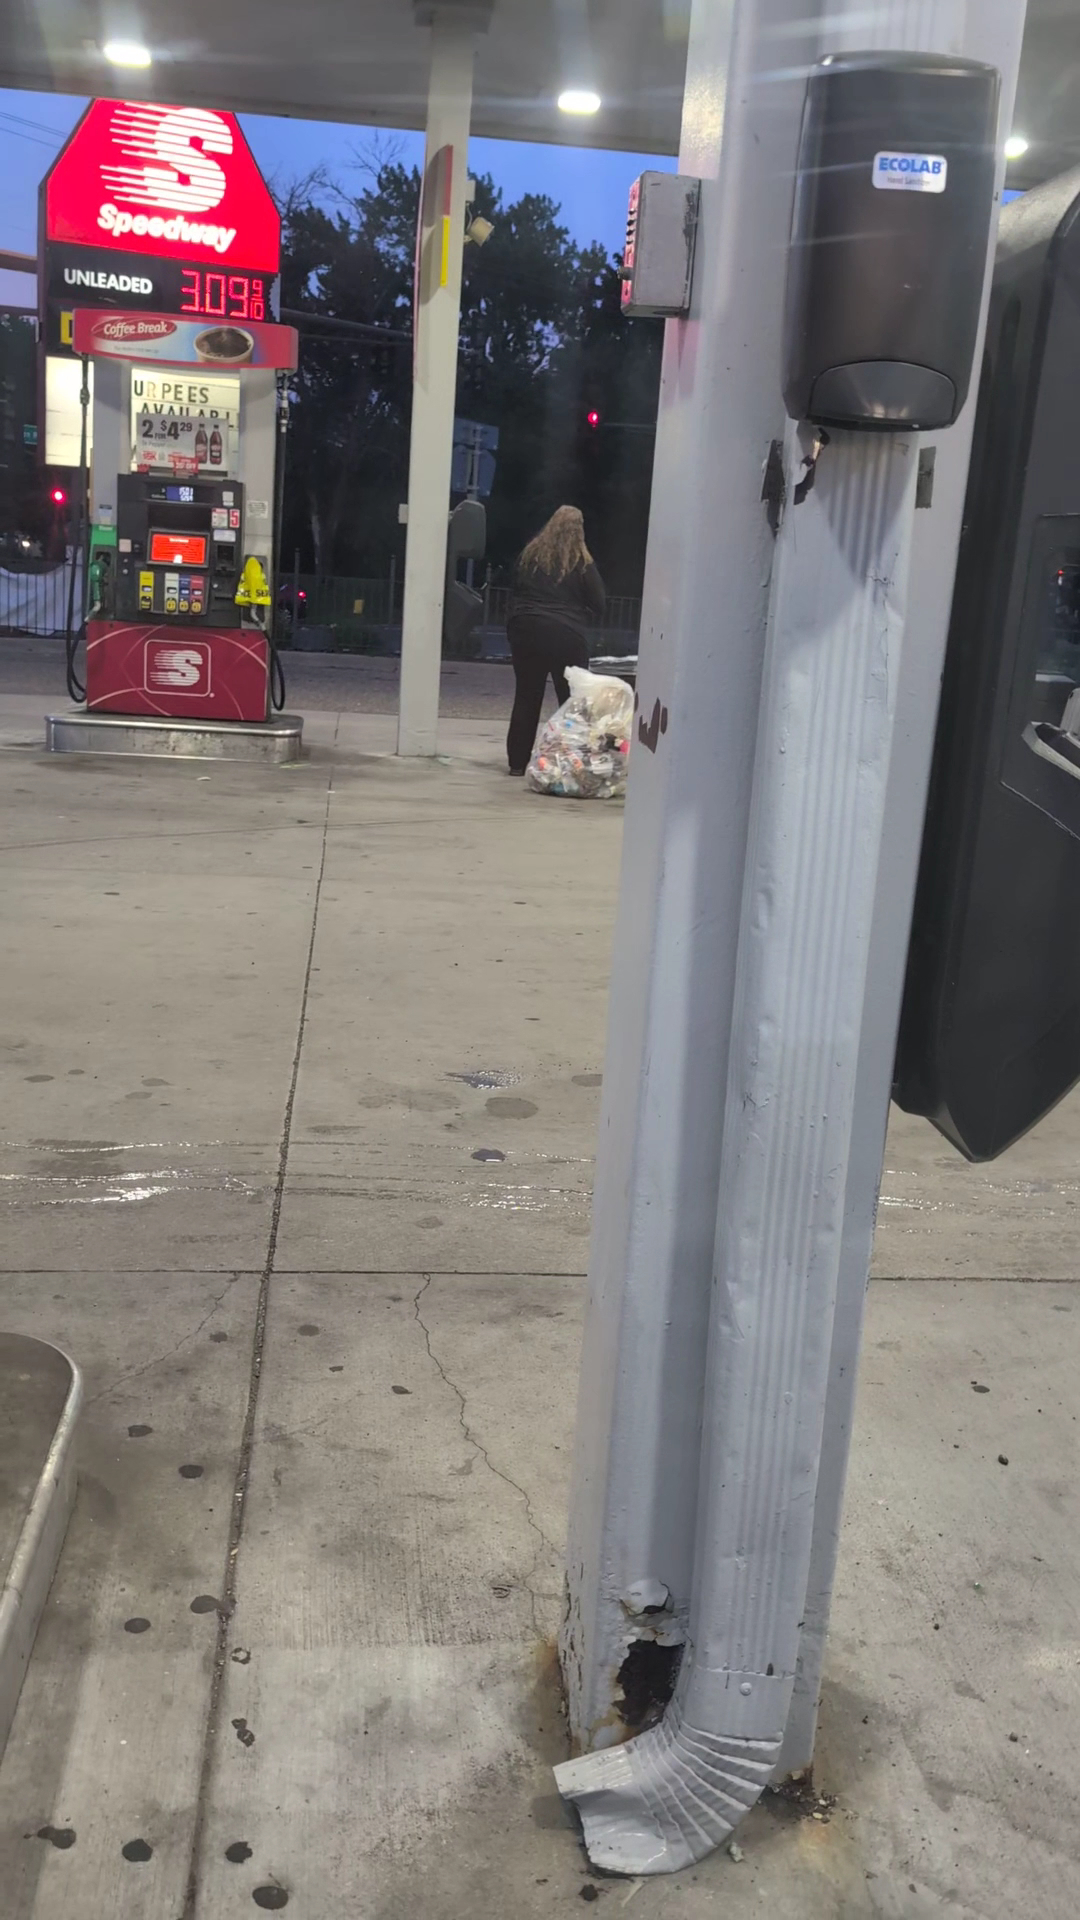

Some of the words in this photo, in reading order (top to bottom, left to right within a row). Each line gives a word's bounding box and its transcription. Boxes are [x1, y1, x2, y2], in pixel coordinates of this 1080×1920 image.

[879, 157, 942, 175] ECOLAB
[97, 203, 236, 253] Speedway
[64, 268, 153, 294] UNLEADED
[104, 322, 135, 338] Coffee
[137, 320, 168, 334] Break
[142, 419, 154, 438] 2
